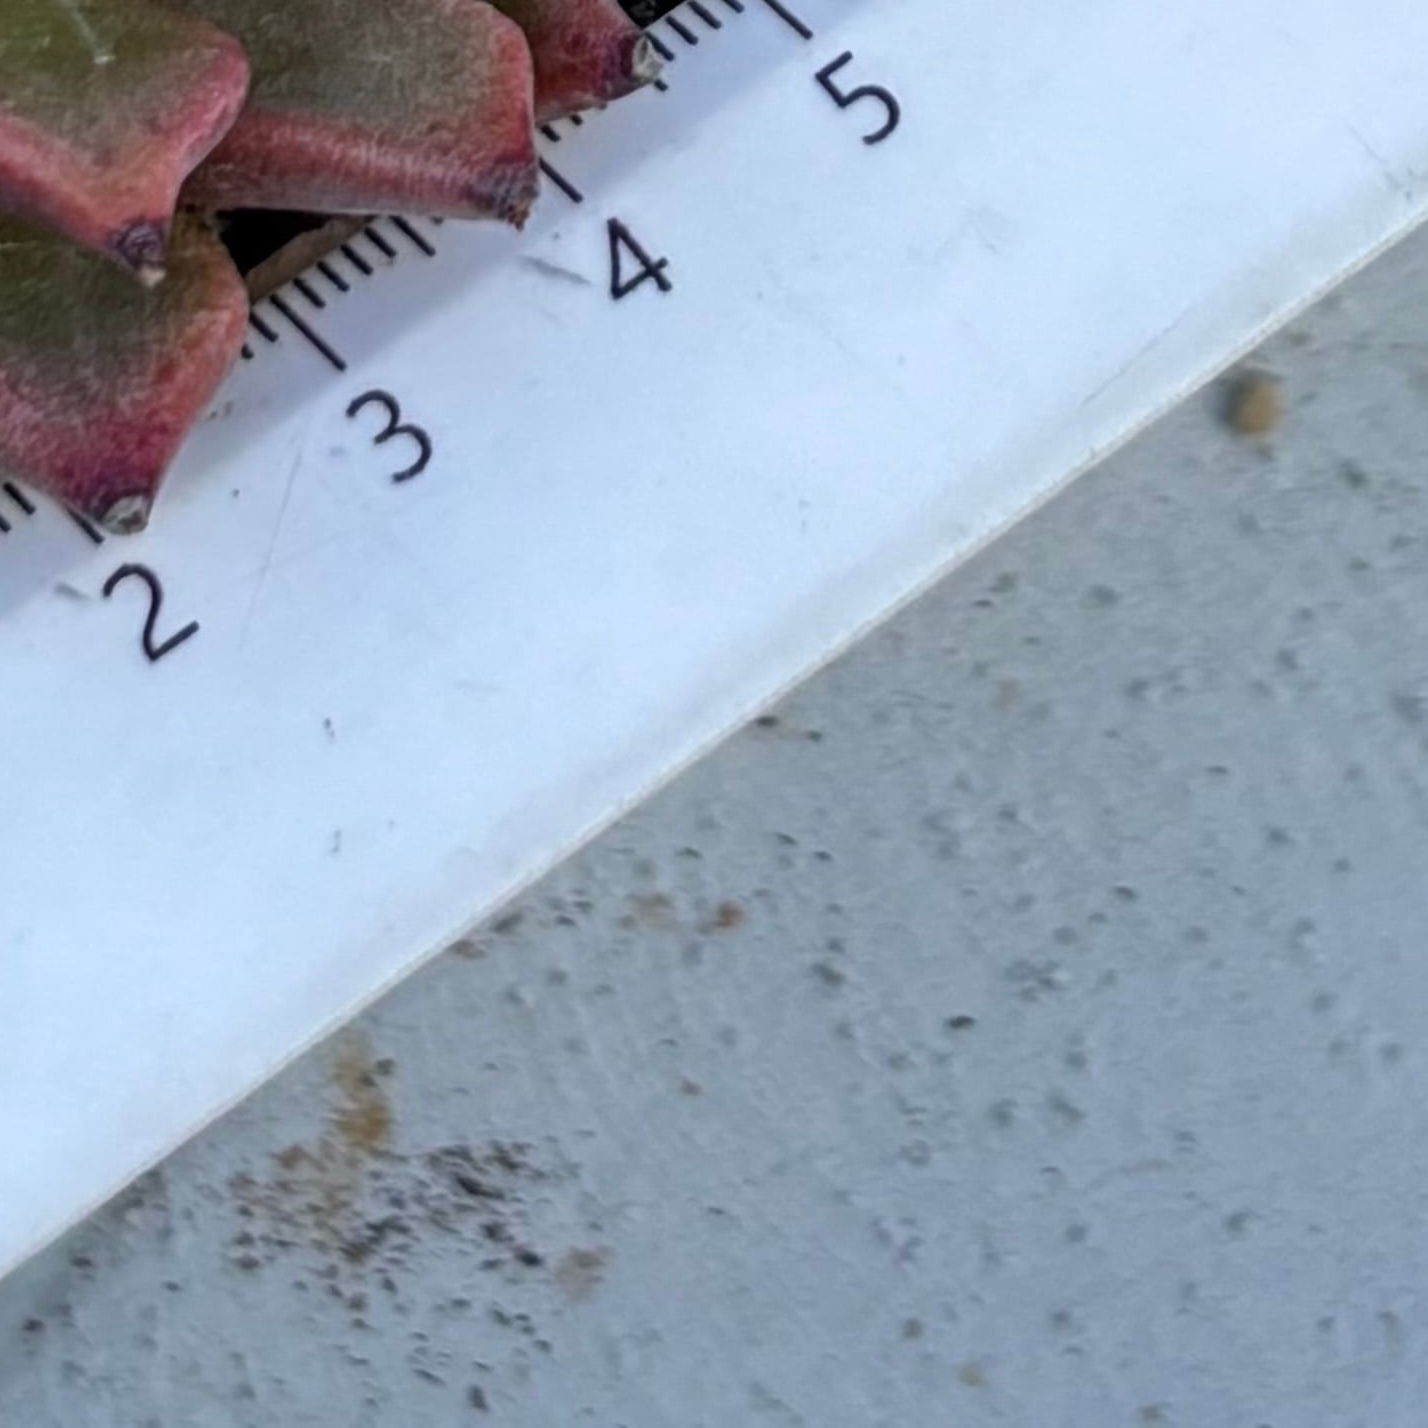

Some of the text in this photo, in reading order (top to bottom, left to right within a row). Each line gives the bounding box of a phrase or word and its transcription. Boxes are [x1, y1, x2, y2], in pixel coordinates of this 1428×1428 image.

[101, 563, 200, 664] 2
[345, 389, 433, 484] 3
[606, 217, 673, 302] 4
[814, 50, 901, 146] 5
